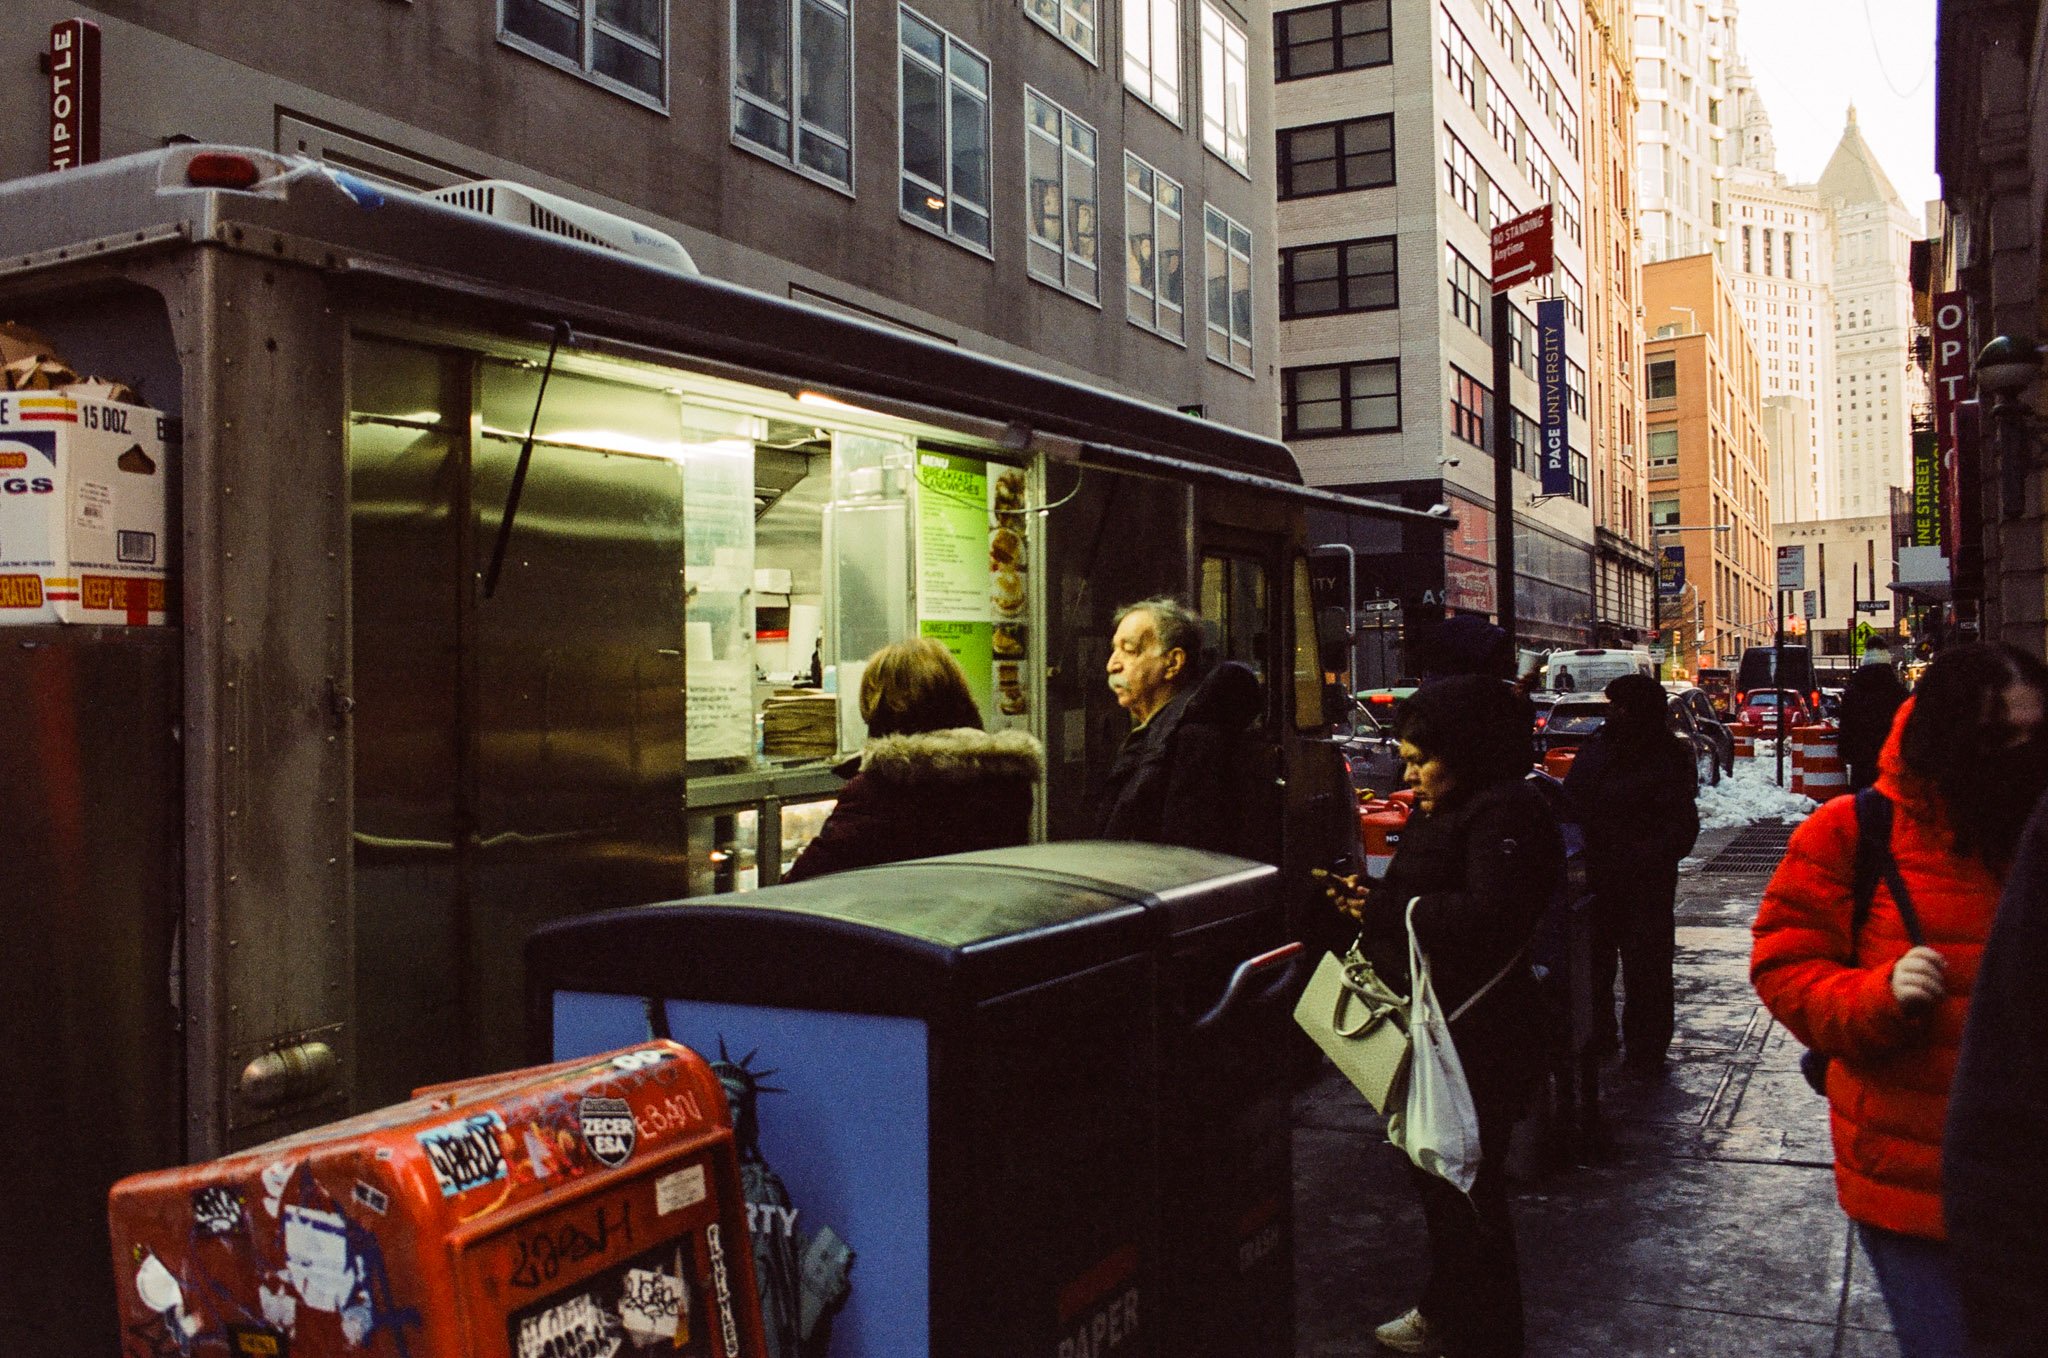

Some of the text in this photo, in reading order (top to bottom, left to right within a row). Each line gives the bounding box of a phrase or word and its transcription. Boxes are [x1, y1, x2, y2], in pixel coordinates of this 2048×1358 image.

[1493, 214, 1544, 246] NO STANDING
[1495, 241, 1525, 261] Anytime
[1544, 326, 1562, 470] PACE UNIVERSITY
[83, 405, 99, 429] 15
[921, 454, 949, 469] MENU
[1914, 456, 1930, 506] STREET
[1790, 528, 1827, 537] PACE
[1386, 833, 1400, 843] NO
[583, 1117, 634, 1136] ZECER
[594, 1135, 627, 1153] ESA
